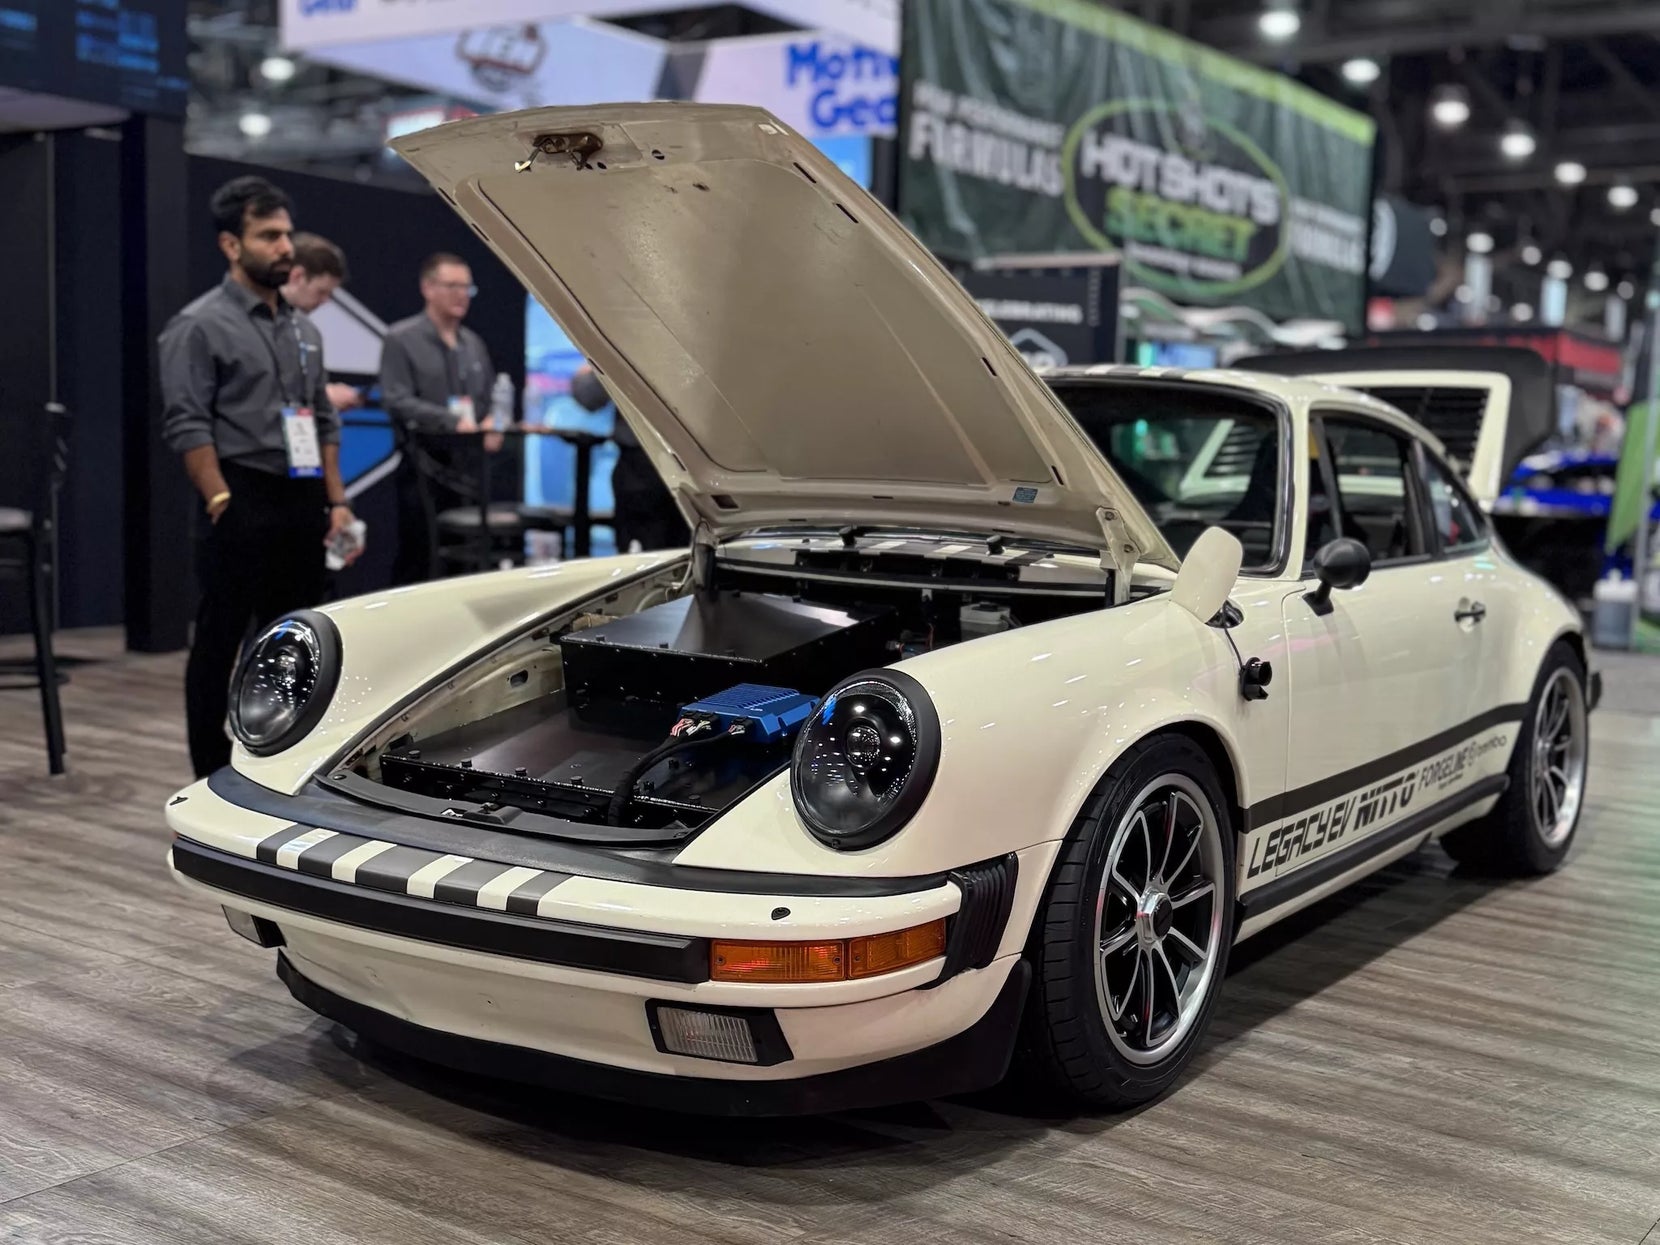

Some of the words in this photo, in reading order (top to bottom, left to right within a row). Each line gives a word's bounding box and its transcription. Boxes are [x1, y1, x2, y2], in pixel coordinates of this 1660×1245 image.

[1081, 129, 1160, 194] HOT
[1104, 185, 1257, 262] SECRET
[1353, 772, 1416, 831] NITTO
